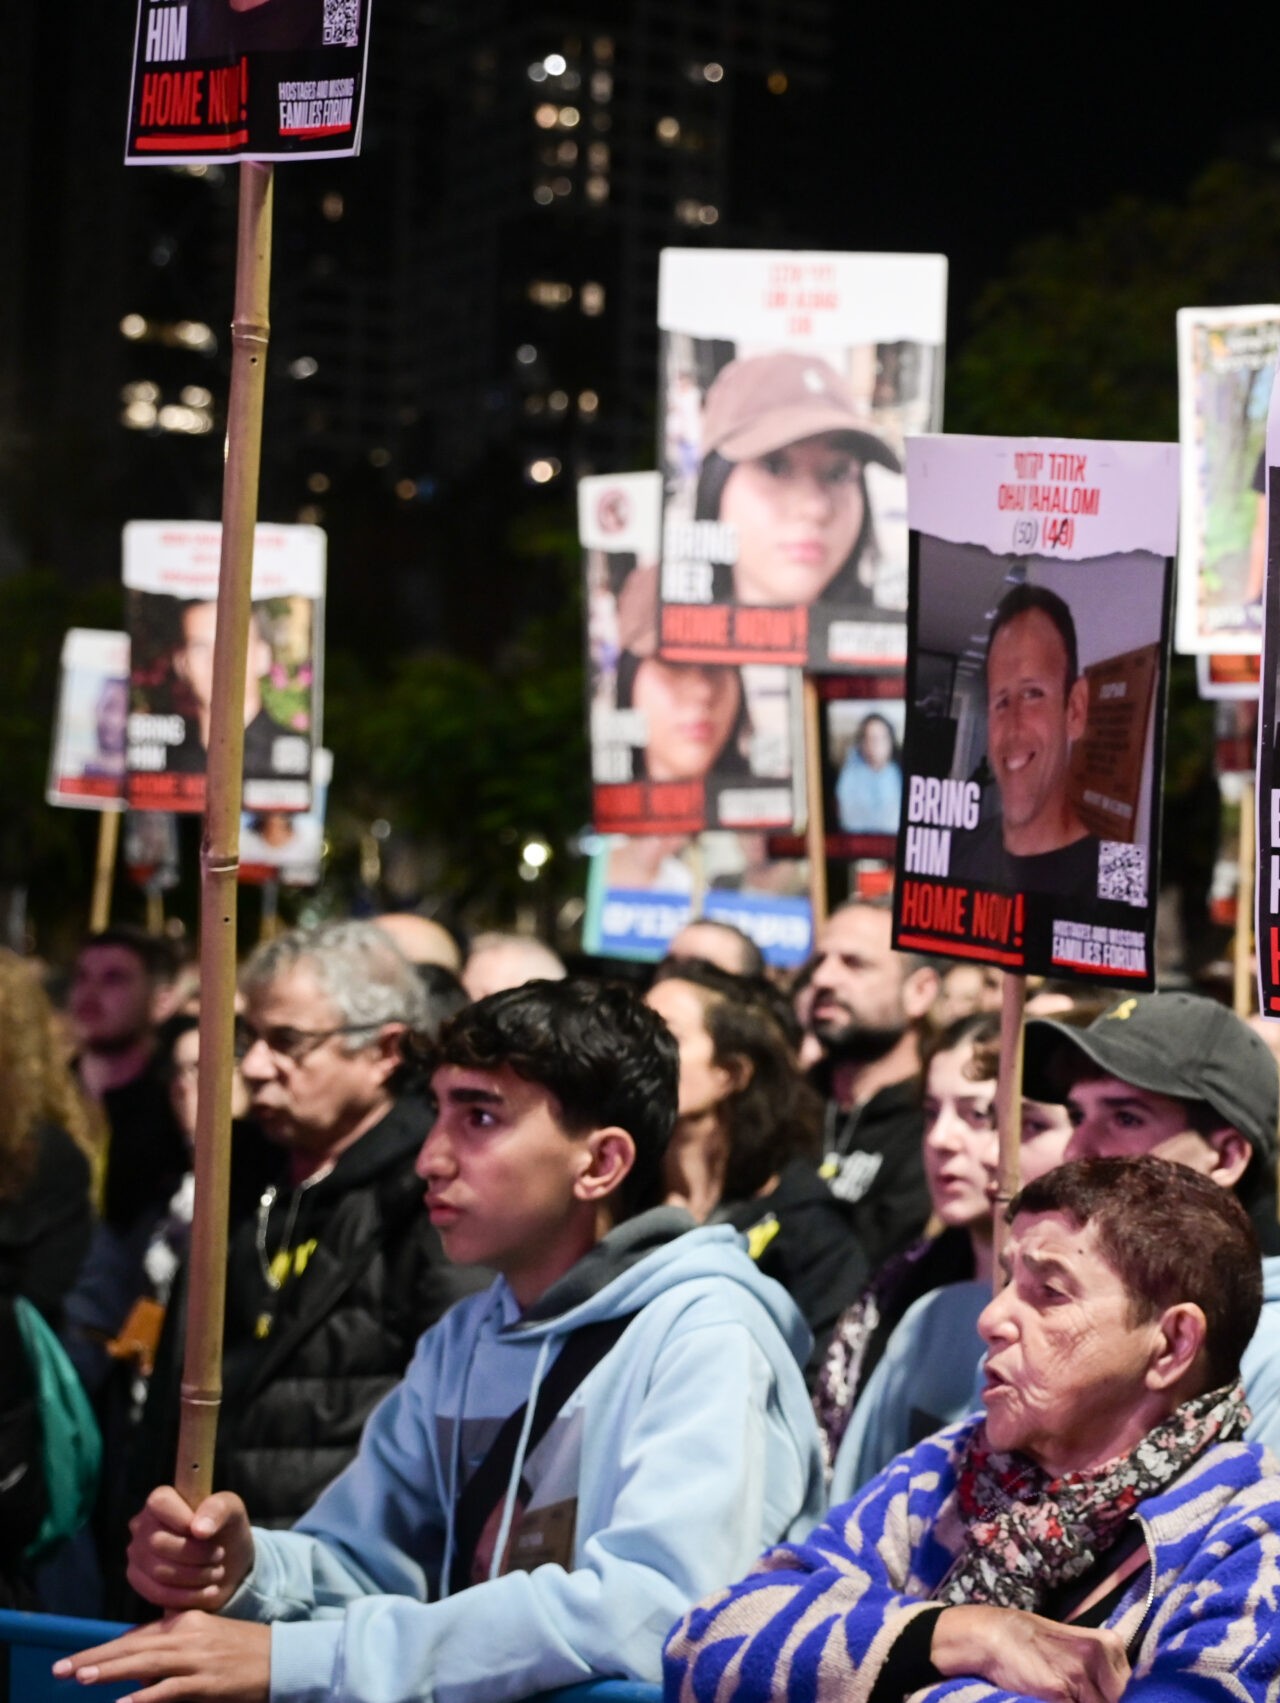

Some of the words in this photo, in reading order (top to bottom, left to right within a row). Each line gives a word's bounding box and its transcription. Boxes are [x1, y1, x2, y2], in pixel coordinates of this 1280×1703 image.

[145, 5, 188, 62] HIM
[140, 71, 204, 126] HOME
[279, 100, 323, 129] FAMILIES
[322, 97, 353, 127] FORUM
[908, 775, 981, 831] BRING
[904, 825, 952, 878] HIM
[902, 880, 968, 937] HOME
[972, 893, 1025, 947] NOW!
